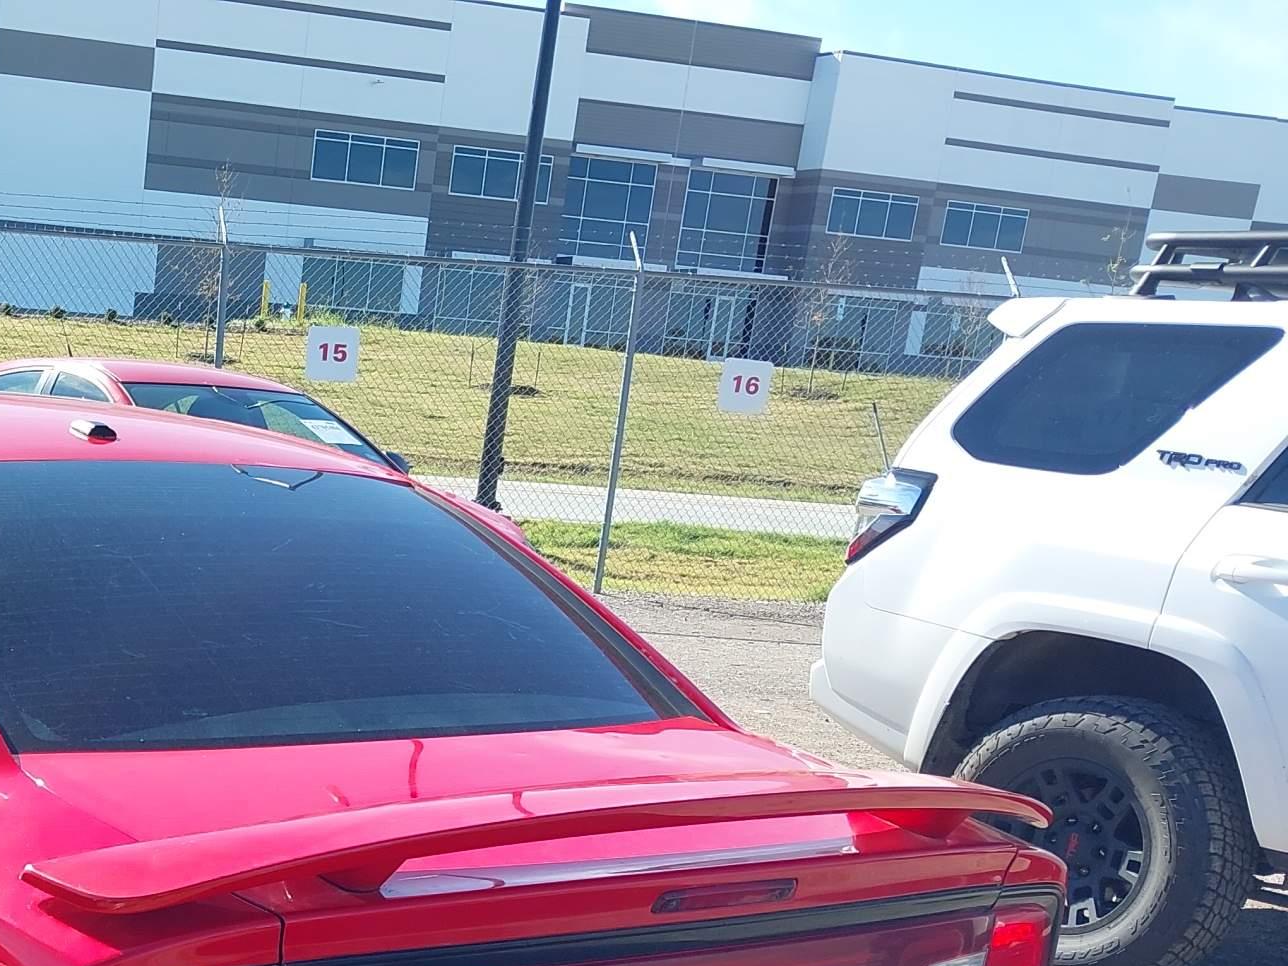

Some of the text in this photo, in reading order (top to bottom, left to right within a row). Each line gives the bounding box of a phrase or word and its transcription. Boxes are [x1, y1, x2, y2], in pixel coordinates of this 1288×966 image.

[318, 342, 348, 363] 15
[733, 375, 761, 395] 16
[1156, 449, 1243, 470] TRD PRO
